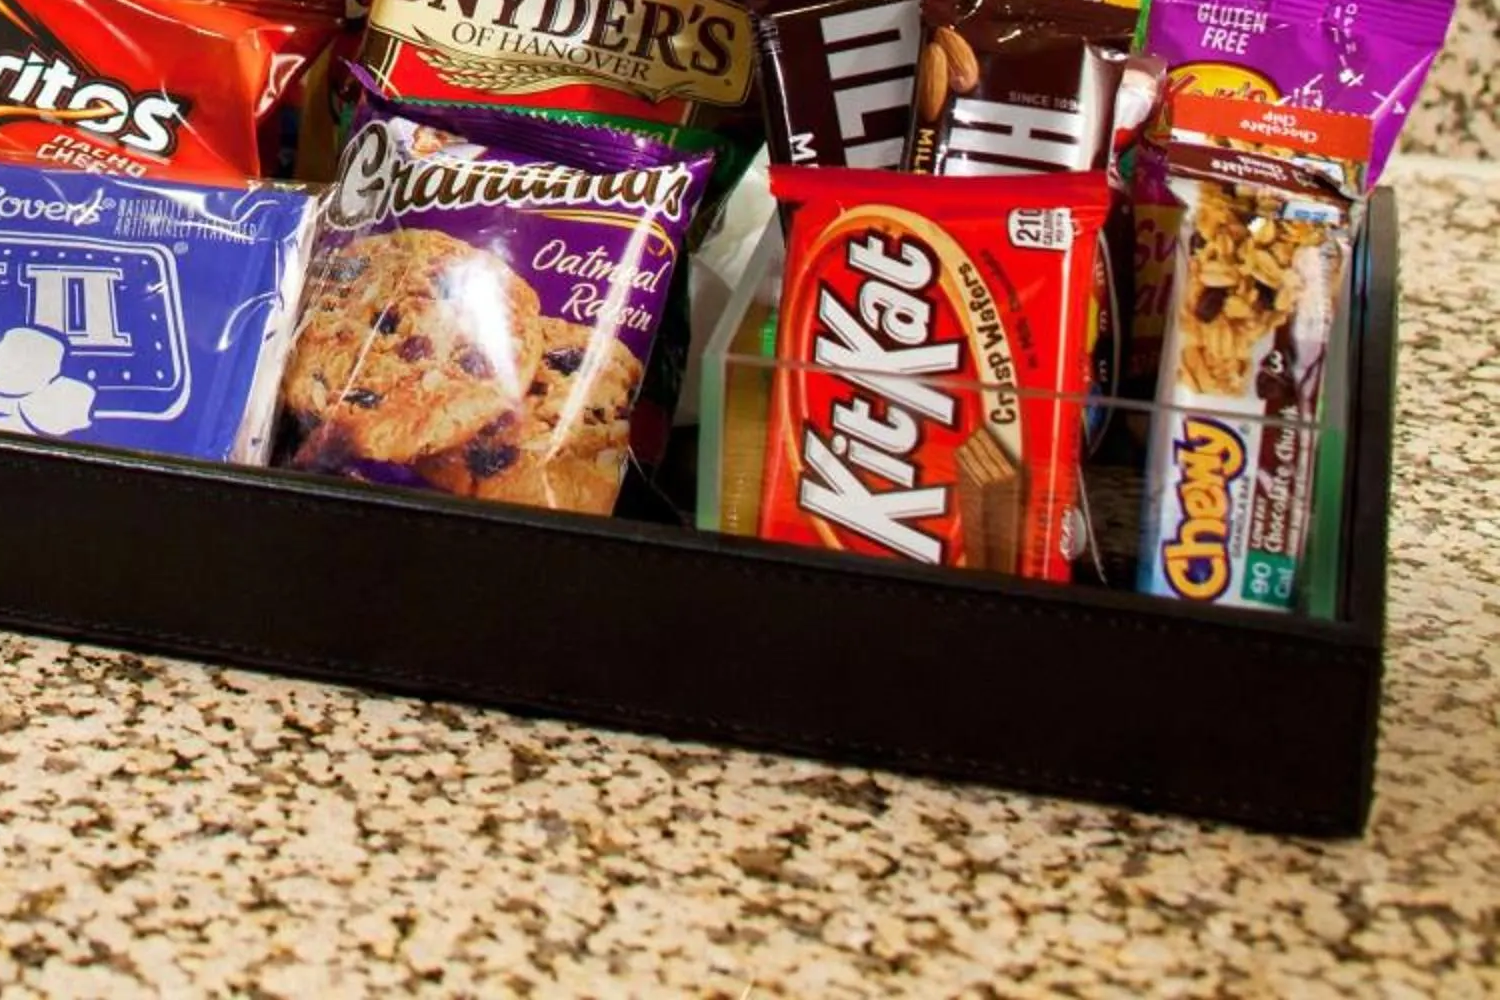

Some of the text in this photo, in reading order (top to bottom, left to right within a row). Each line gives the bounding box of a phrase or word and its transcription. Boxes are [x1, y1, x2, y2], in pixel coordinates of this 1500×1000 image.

[1196, 2, 1269, 33] GLUTEN
[451, 20, 651, 82] OF HANOVER
[1201, 26, 1249, 54] FREE
[1238, 118, 1320, 144] Chocolate
[50, 134, 148, 178] NACHO
[25, 263, 133, 348] II
[957, 261, 1004, 351] Wafers
[1164, 416, 1246, 602] Chewy
[1262, 465, 1291, 553] Chocolate
[1251, 561, 1272, 595] 90
[1273, 567, 1294, 599] Cal
